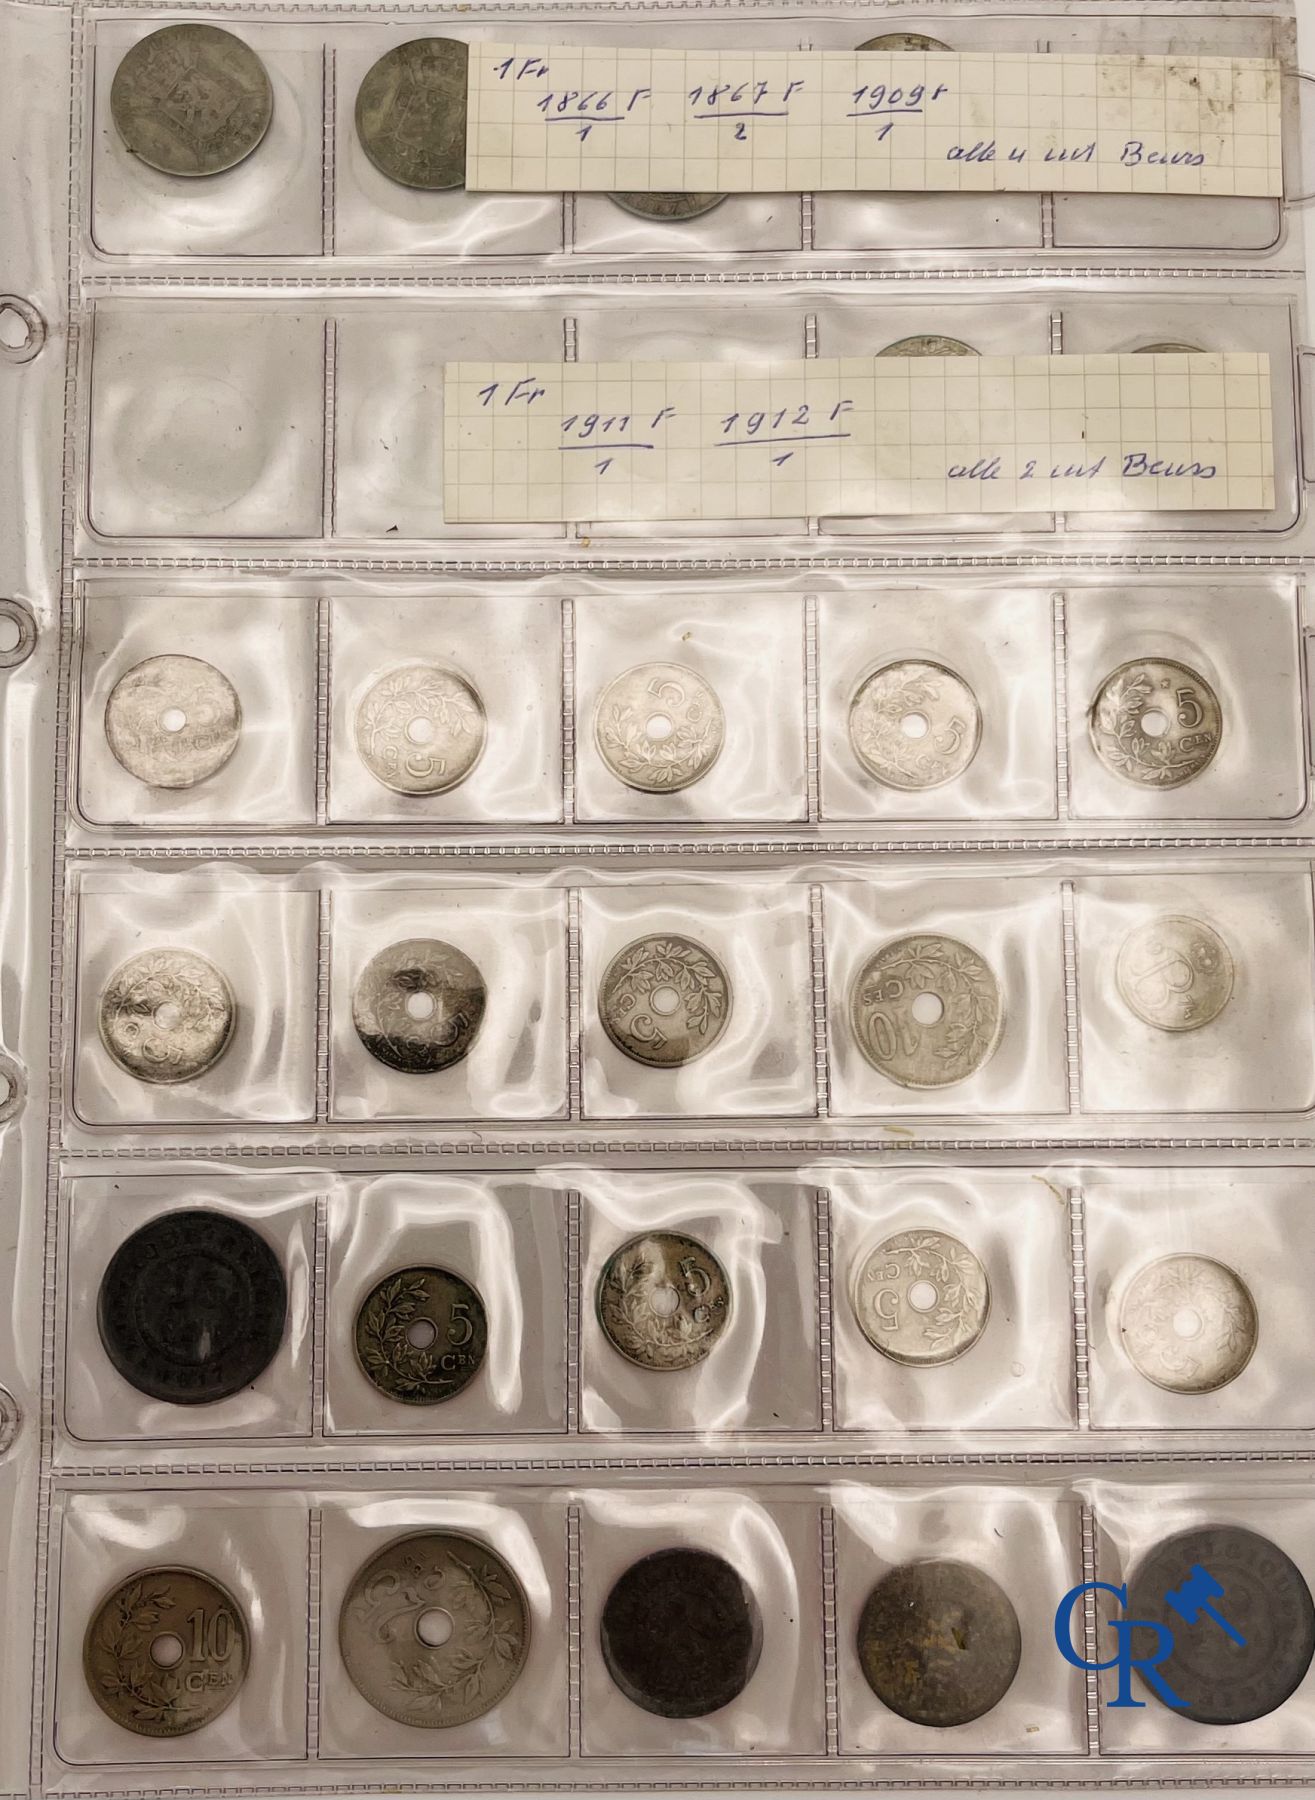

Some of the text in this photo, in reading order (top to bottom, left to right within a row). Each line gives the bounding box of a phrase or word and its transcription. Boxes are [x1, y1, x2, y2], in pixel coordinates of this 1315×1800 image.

[516, 58, 549, 80] Fr
[537, 91, 614, 112] 1866
[690, 81, 769, 105] 1867
[852, 85, 926, 110] 1909
[576, 122, 894, 142] 1 2 1
[946, 140, 995, 162] alle
[479, 377, 546, 406] 1 Fr
[561, 399, 853, 438] 1911 F 1912 F
[594, 452, 793, 475] 1 1
[947, 455, 1001, 479] alle
[1018, 459, 1037, 480] 2
[647, 678, 686, 707] 5
[1176, 688, 1204, 728] 5
[935, 716, 966, 754] 5
[405, 752, 446, 777] 5
[430, 1011, 469, 1046] 5
[629, 1013, 667, 1050] 5
[868, 1011, 920, 1061] 10
[680, 1255, 711, 1298] 5
[446, 1303, 474, 1346] 5
[873, 1288, 899, 1331] 5
[185, 1607, 236, 1662] 10
